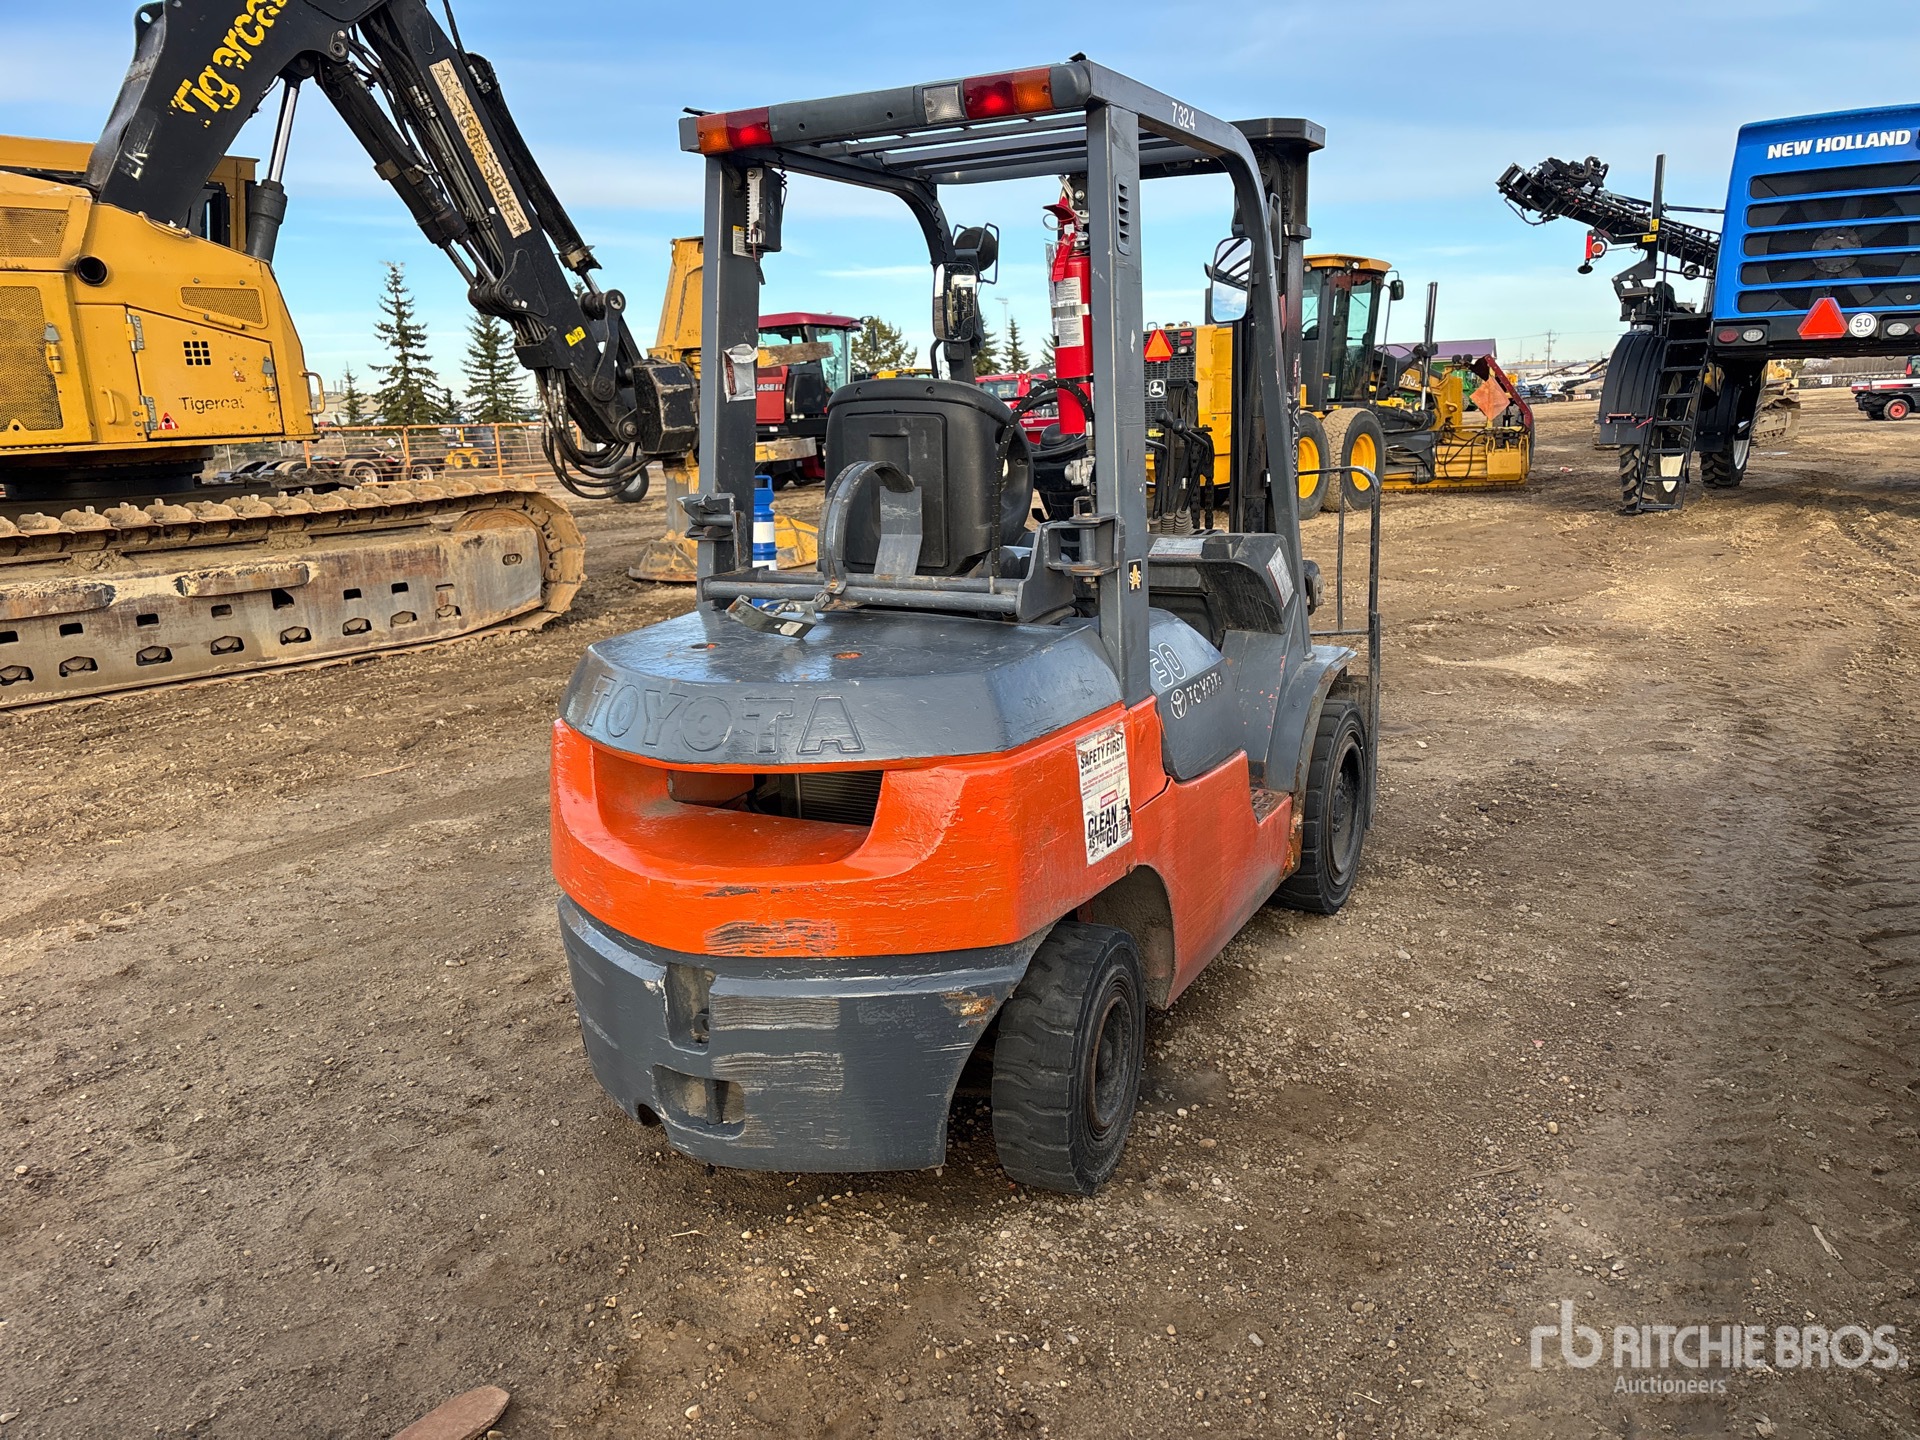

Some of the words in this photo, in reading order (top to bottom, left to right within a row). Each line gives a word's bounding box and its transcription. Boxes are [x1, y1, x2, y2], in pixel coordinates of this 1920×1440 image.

[1172, 101, 1195, 130] 7324
[1767, 140, 1813, 159] NEW
[1815, 130, 1911, 153] HOLLAND
[1855, 317, 1872, 328] 50
[586, 674, 867, 756] TOYOTA
[1081, 743, 1106, 769] SAFETY
[1106, 736, 1124, 757] FIRST
[1088, 803, 1117, 840] CLEAN
[1088, 835, 1096, 850] AS
[1096, 829, 1106, 846] YOU
[1106, 823, 1119, 848] GO
